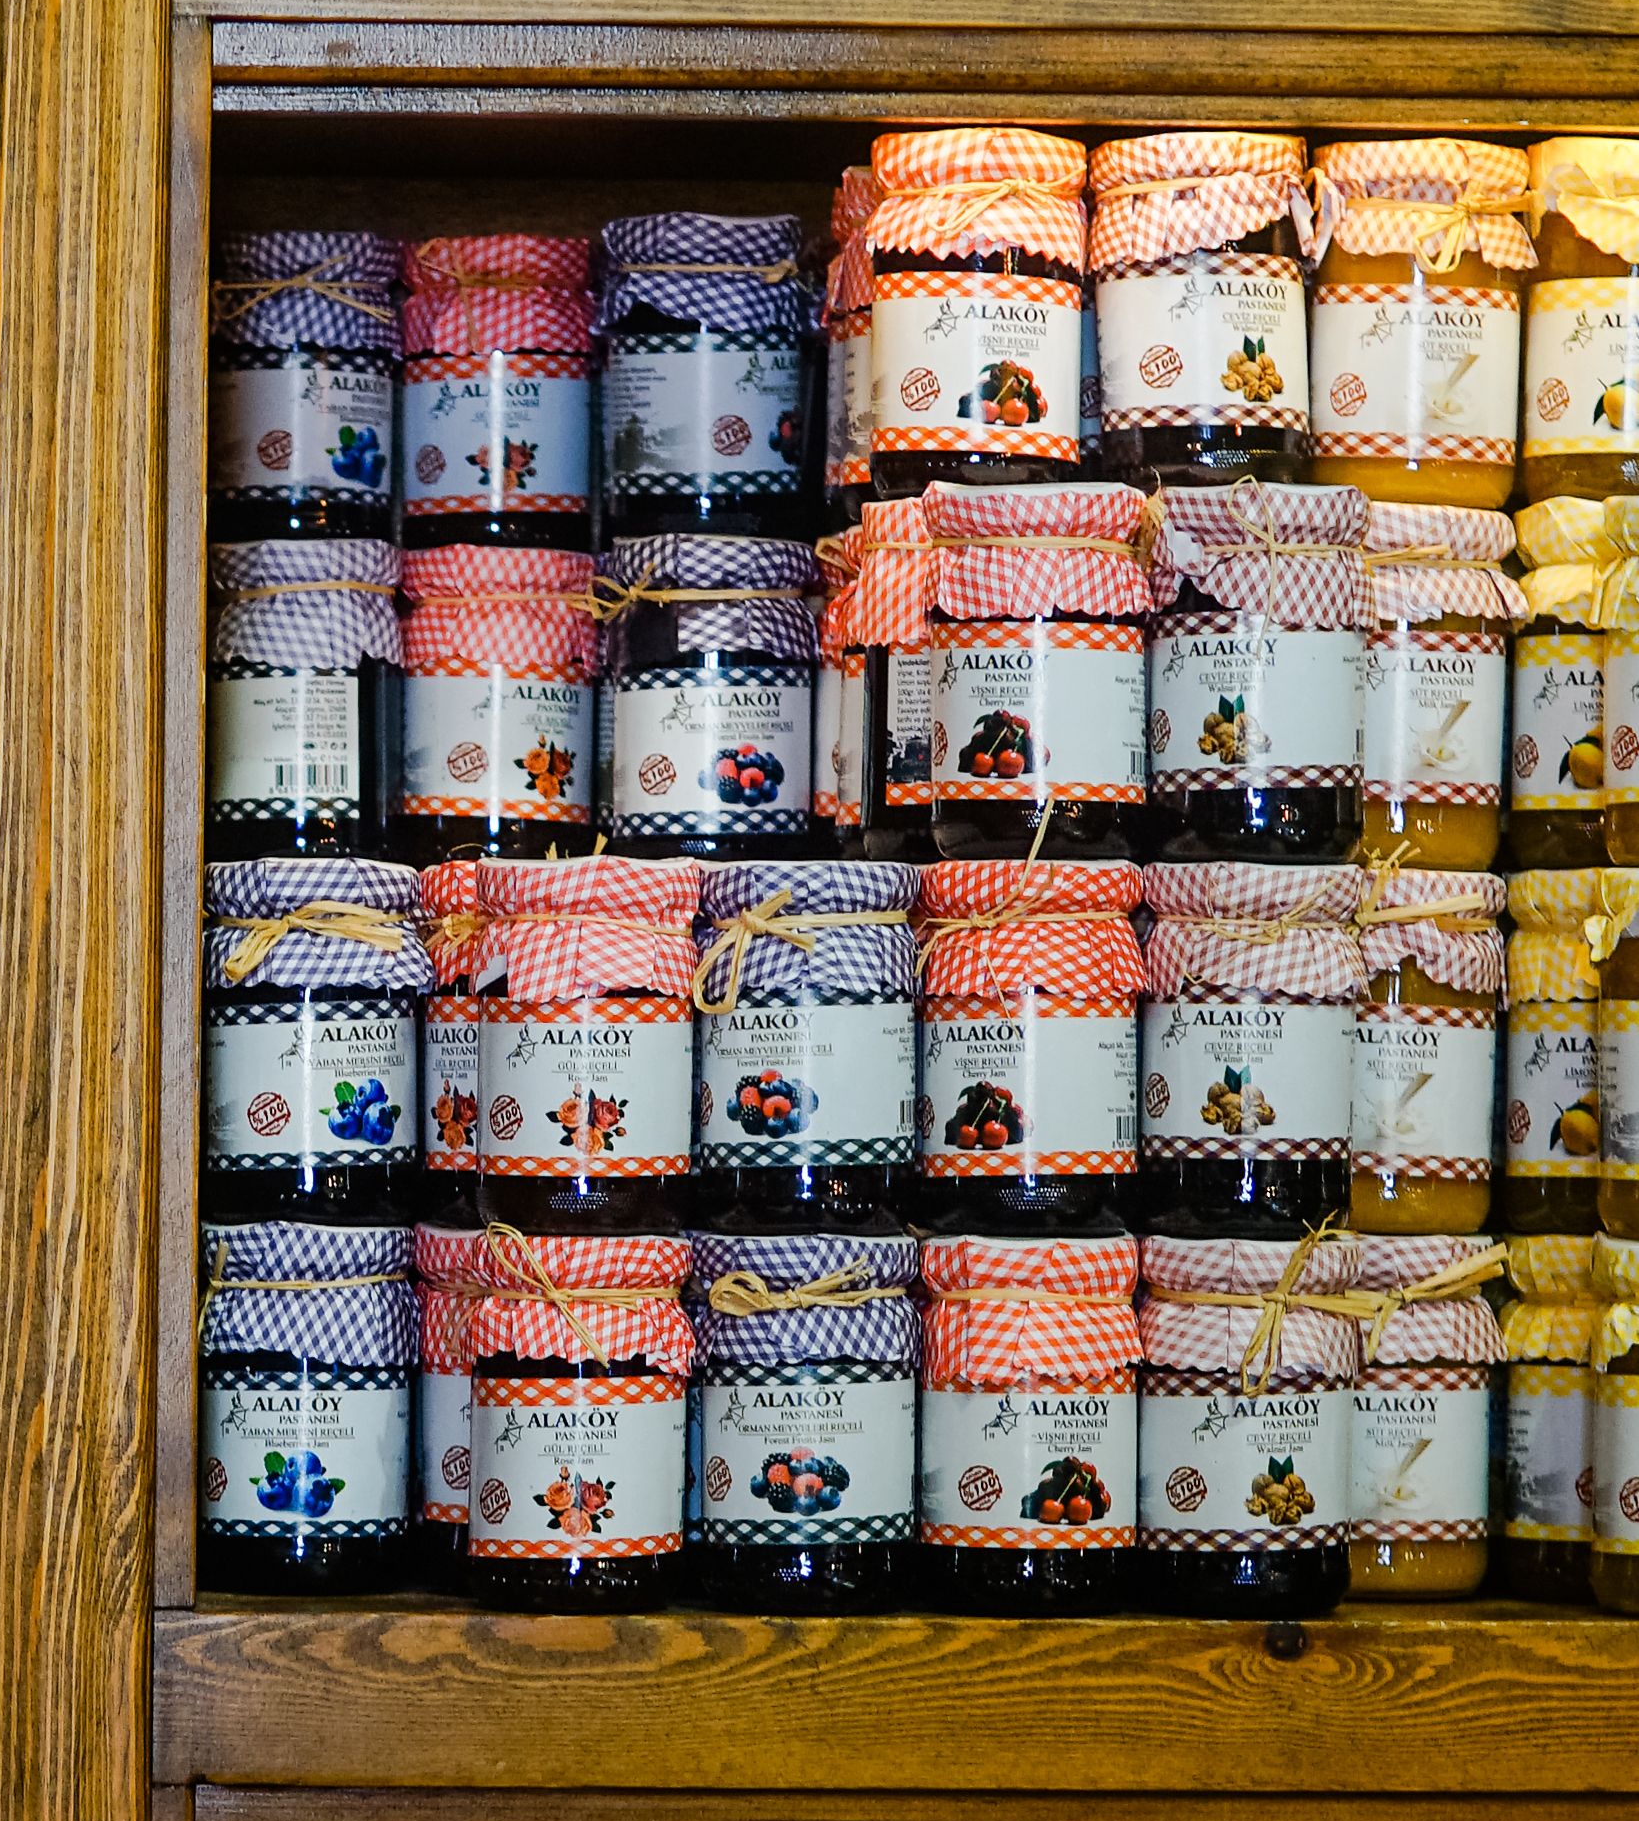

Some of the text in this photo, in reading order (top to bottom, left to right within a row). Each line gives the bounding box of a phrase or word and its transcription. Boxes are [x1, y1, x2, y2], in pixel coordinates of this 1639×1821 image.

[1210, 280, 1286, 301] ALAKÖY
[963, 303, 1049, 325] ALAKÖY
[1192, 1005, 1285, 1027] ALAKÖY
[321, 1025, 397, 1046] ALAKÖY
[945, 1021, 1026, 1043] ALAKÖY
[1220, 1028, 1282, 1039] PASTANESİ
[966, 1043, 1025, 1055] PASTANESİ
[753, 1386, 845, 1408] ALAKÖY
[1025, 1396, 1109, 1416] ALAKÖY
[1233, 1395, 1320, 1416] ALAKÖY
[527, 1407, 618, 1428] ALAKÖY
[781, 1409, 842, 1421] PASTANESİ
[1054, 1417, 1108, 1429] PASTANESİ
[1262, 1416, 1319, 1429] PASTANESİ
[1077, 1444, 1092, 1453] Jam
